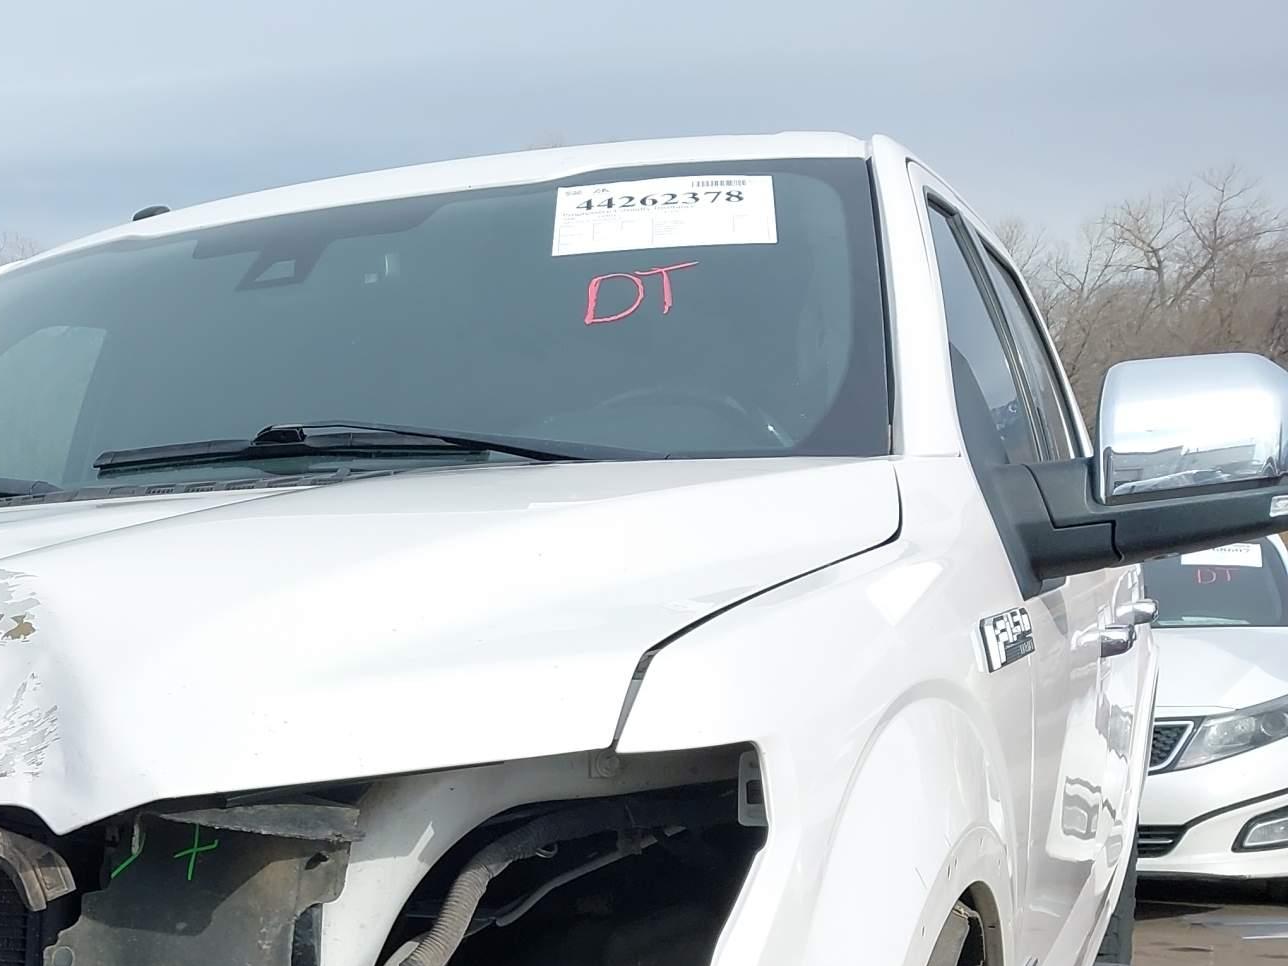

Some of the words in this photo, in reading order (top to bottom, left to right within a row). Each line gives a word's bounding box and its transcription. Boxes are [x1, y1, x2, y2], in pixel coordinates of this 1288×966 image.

[575, 189, 745, 211] 44262378
[584, 261, 700, 325] DT
[1196, 566, 1241, 584] DT
